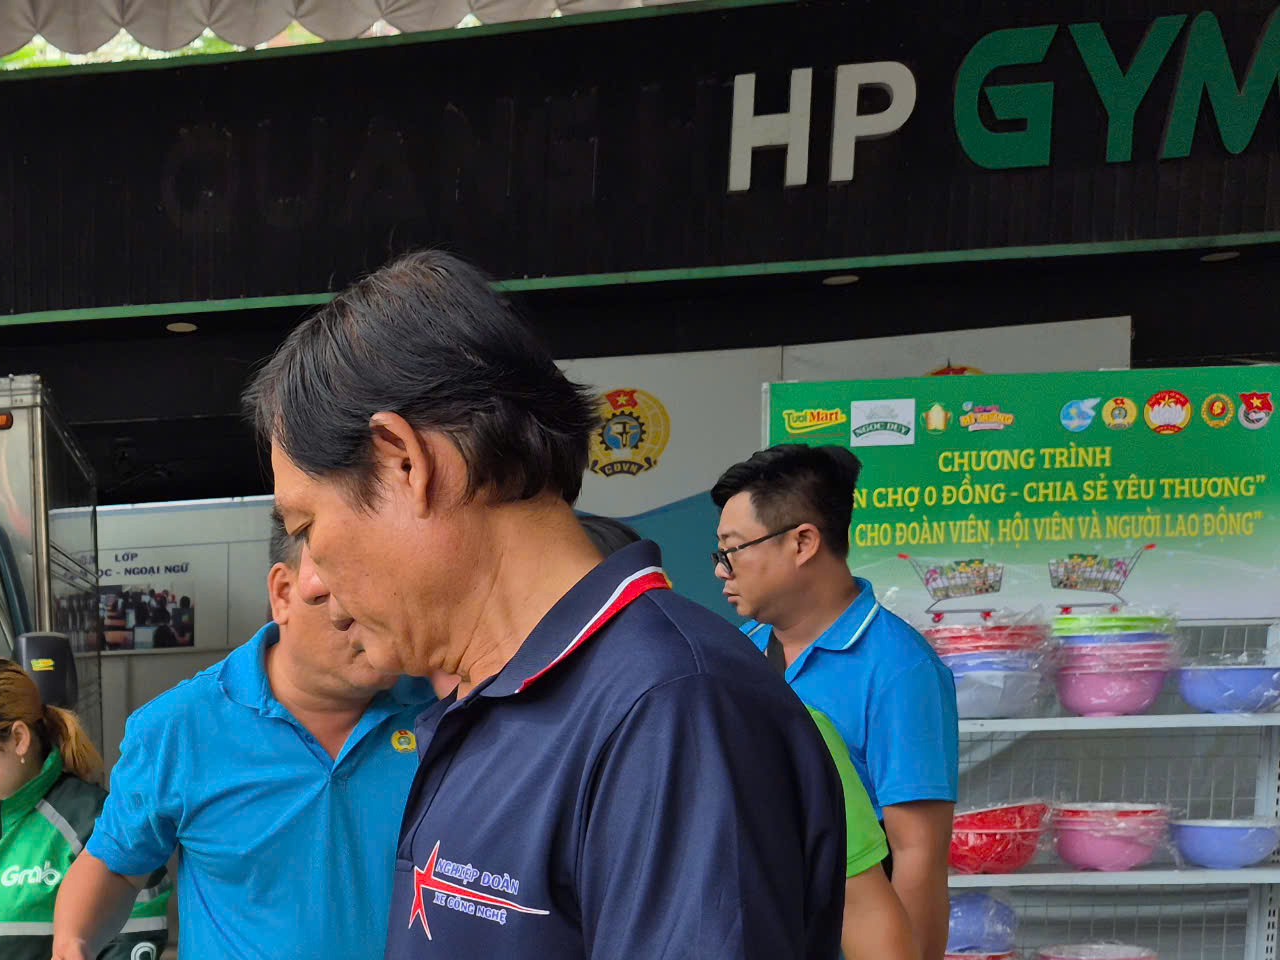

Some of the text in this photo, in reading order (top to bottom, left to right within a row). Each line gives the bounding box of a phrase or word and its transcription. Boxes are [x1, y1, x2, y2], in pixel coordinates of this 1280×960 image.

[727, 60, 917, 194] HP
[1039, 441, 1113, 470] TRÌNH
[924, 485, 937, 507] 0
[941, 472, 1007, 506] ĐỒNG
[1023, 480, 1079, 503] CHIA
[1082, 472, 1110, 502] SẺ
[1112, 473, 1156, 500] YÊU
[855, 523, 893, 547] CHO
[895, 514, 946, 546] ĐOÀN
[949, 513, 995, 547] VIÊN,
[997, 511, 1029, 549] HỘI
[1033, 511, 1074, 541] VIÊN
[1077, 508, 1103, 540] VÀ
[1105, 505, 1162, 539] NGƯỜI
[1165, 513, 1200, 537] LAO
[1, 860, 62, 887] Grab
[434, 857, 520, 896] NGHIỆP ĐOÀN
[447, 896, 475, 915] CÔNG
